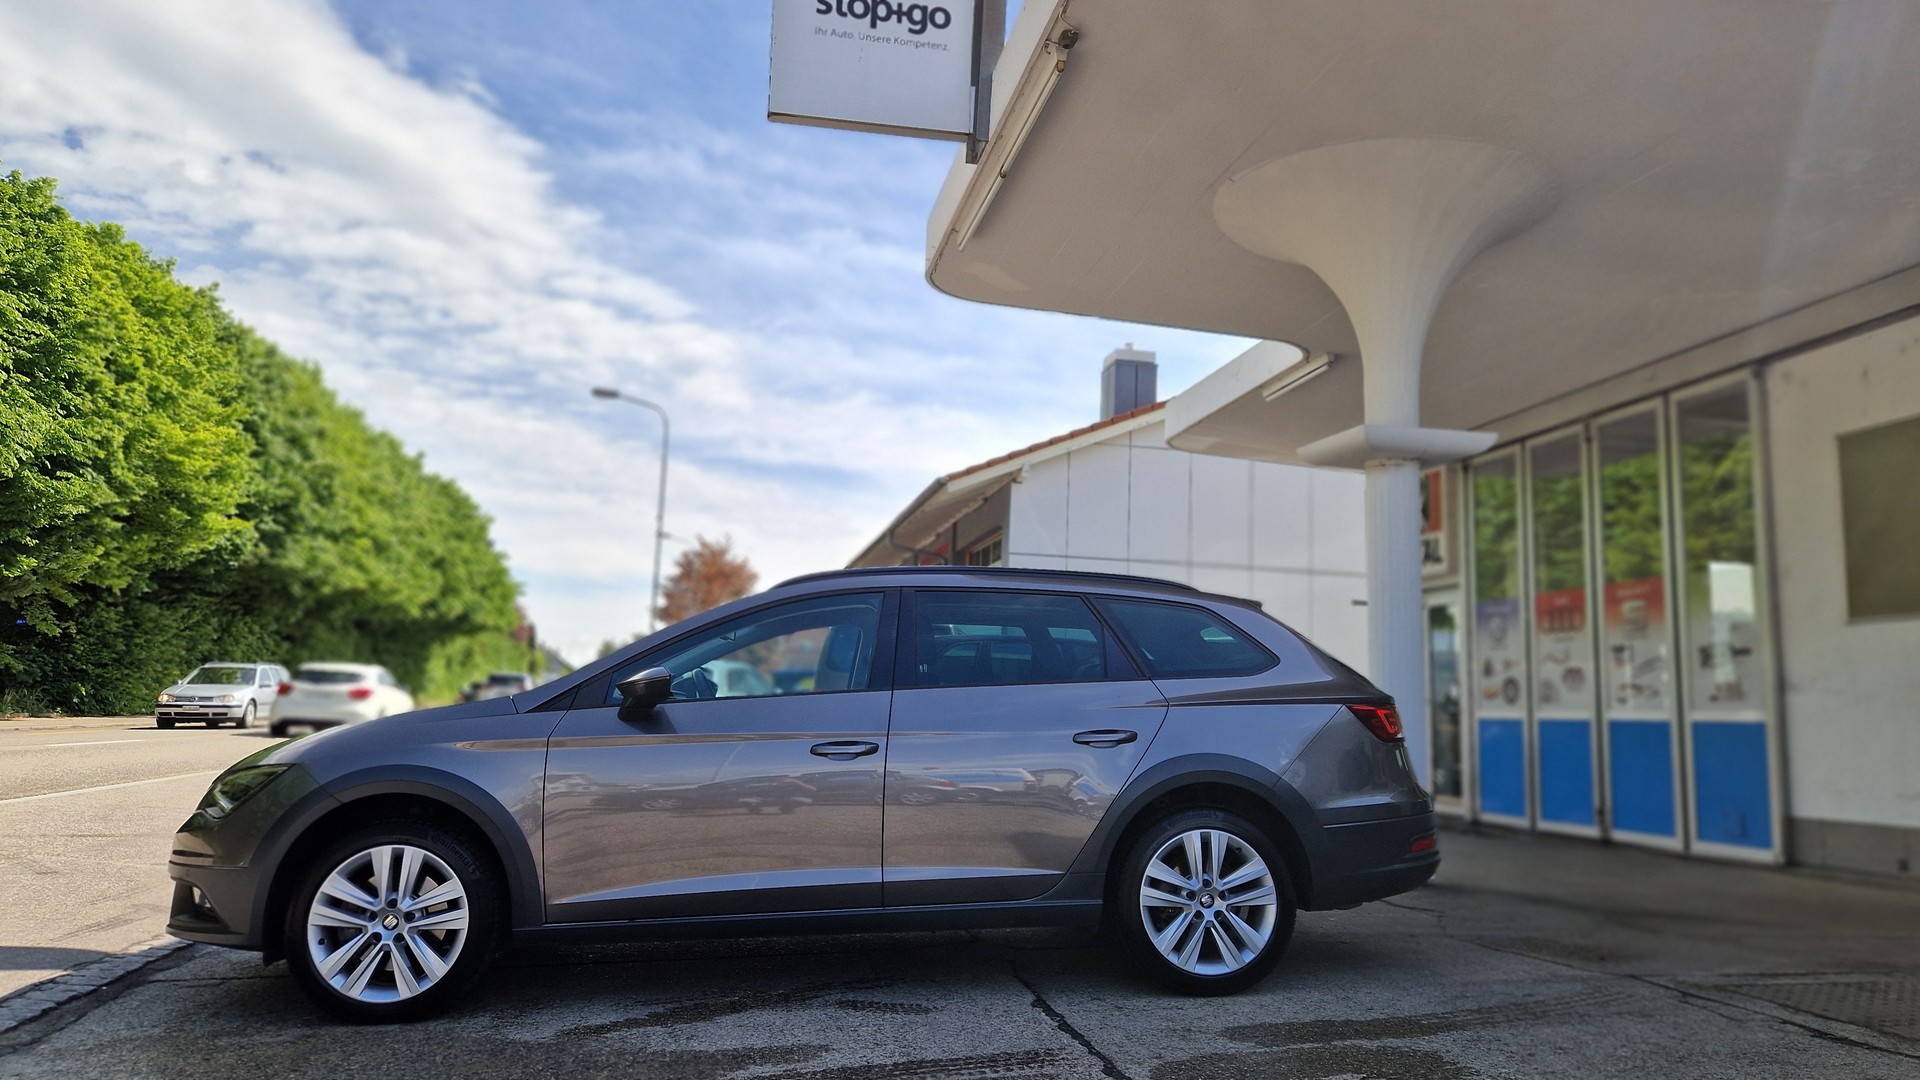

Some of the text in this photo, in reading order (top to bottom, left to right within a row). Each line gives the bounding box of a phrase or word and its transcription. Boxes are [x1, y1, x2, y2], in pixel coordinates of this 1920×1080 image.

[815, 26, 828, 36] Ihr
[830, 28, 856, 40] Auto.
[858, 32, 892, 45] Unsere
